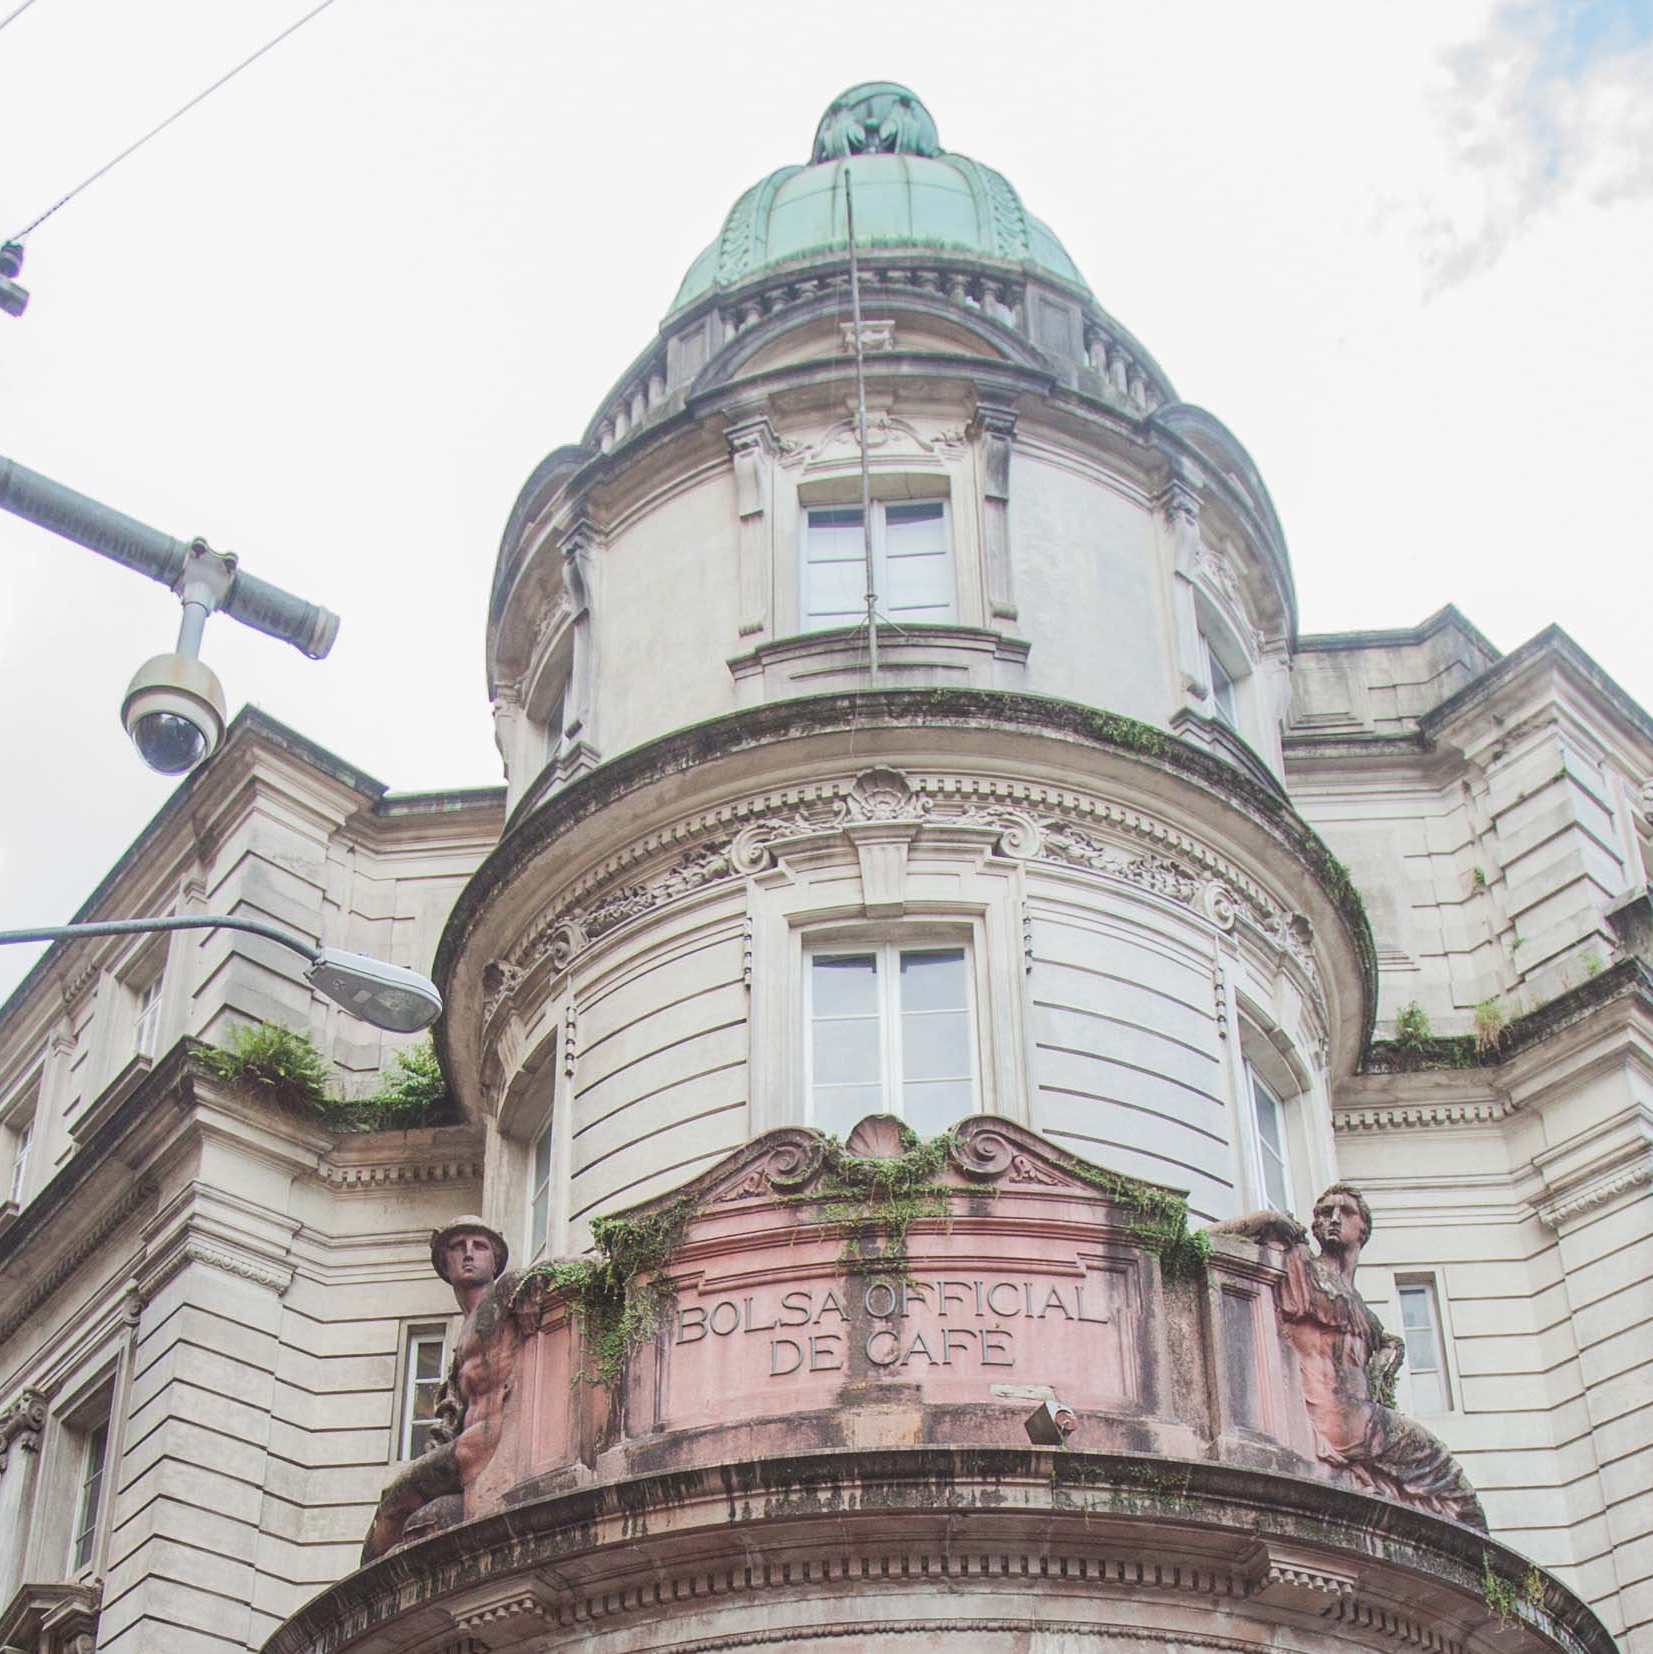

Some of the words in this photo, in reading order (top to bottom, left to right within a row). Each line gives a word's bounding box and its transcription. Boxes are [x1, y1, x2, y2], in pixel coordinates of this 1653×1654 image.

[676, 1289, 850, 1345] BOLSA
[865, 1280, 1109, 1324] OFFICIAL
[770, 1334, 844, 1377] DE
[866, 1322, 1015, 1366] CAFÉ
